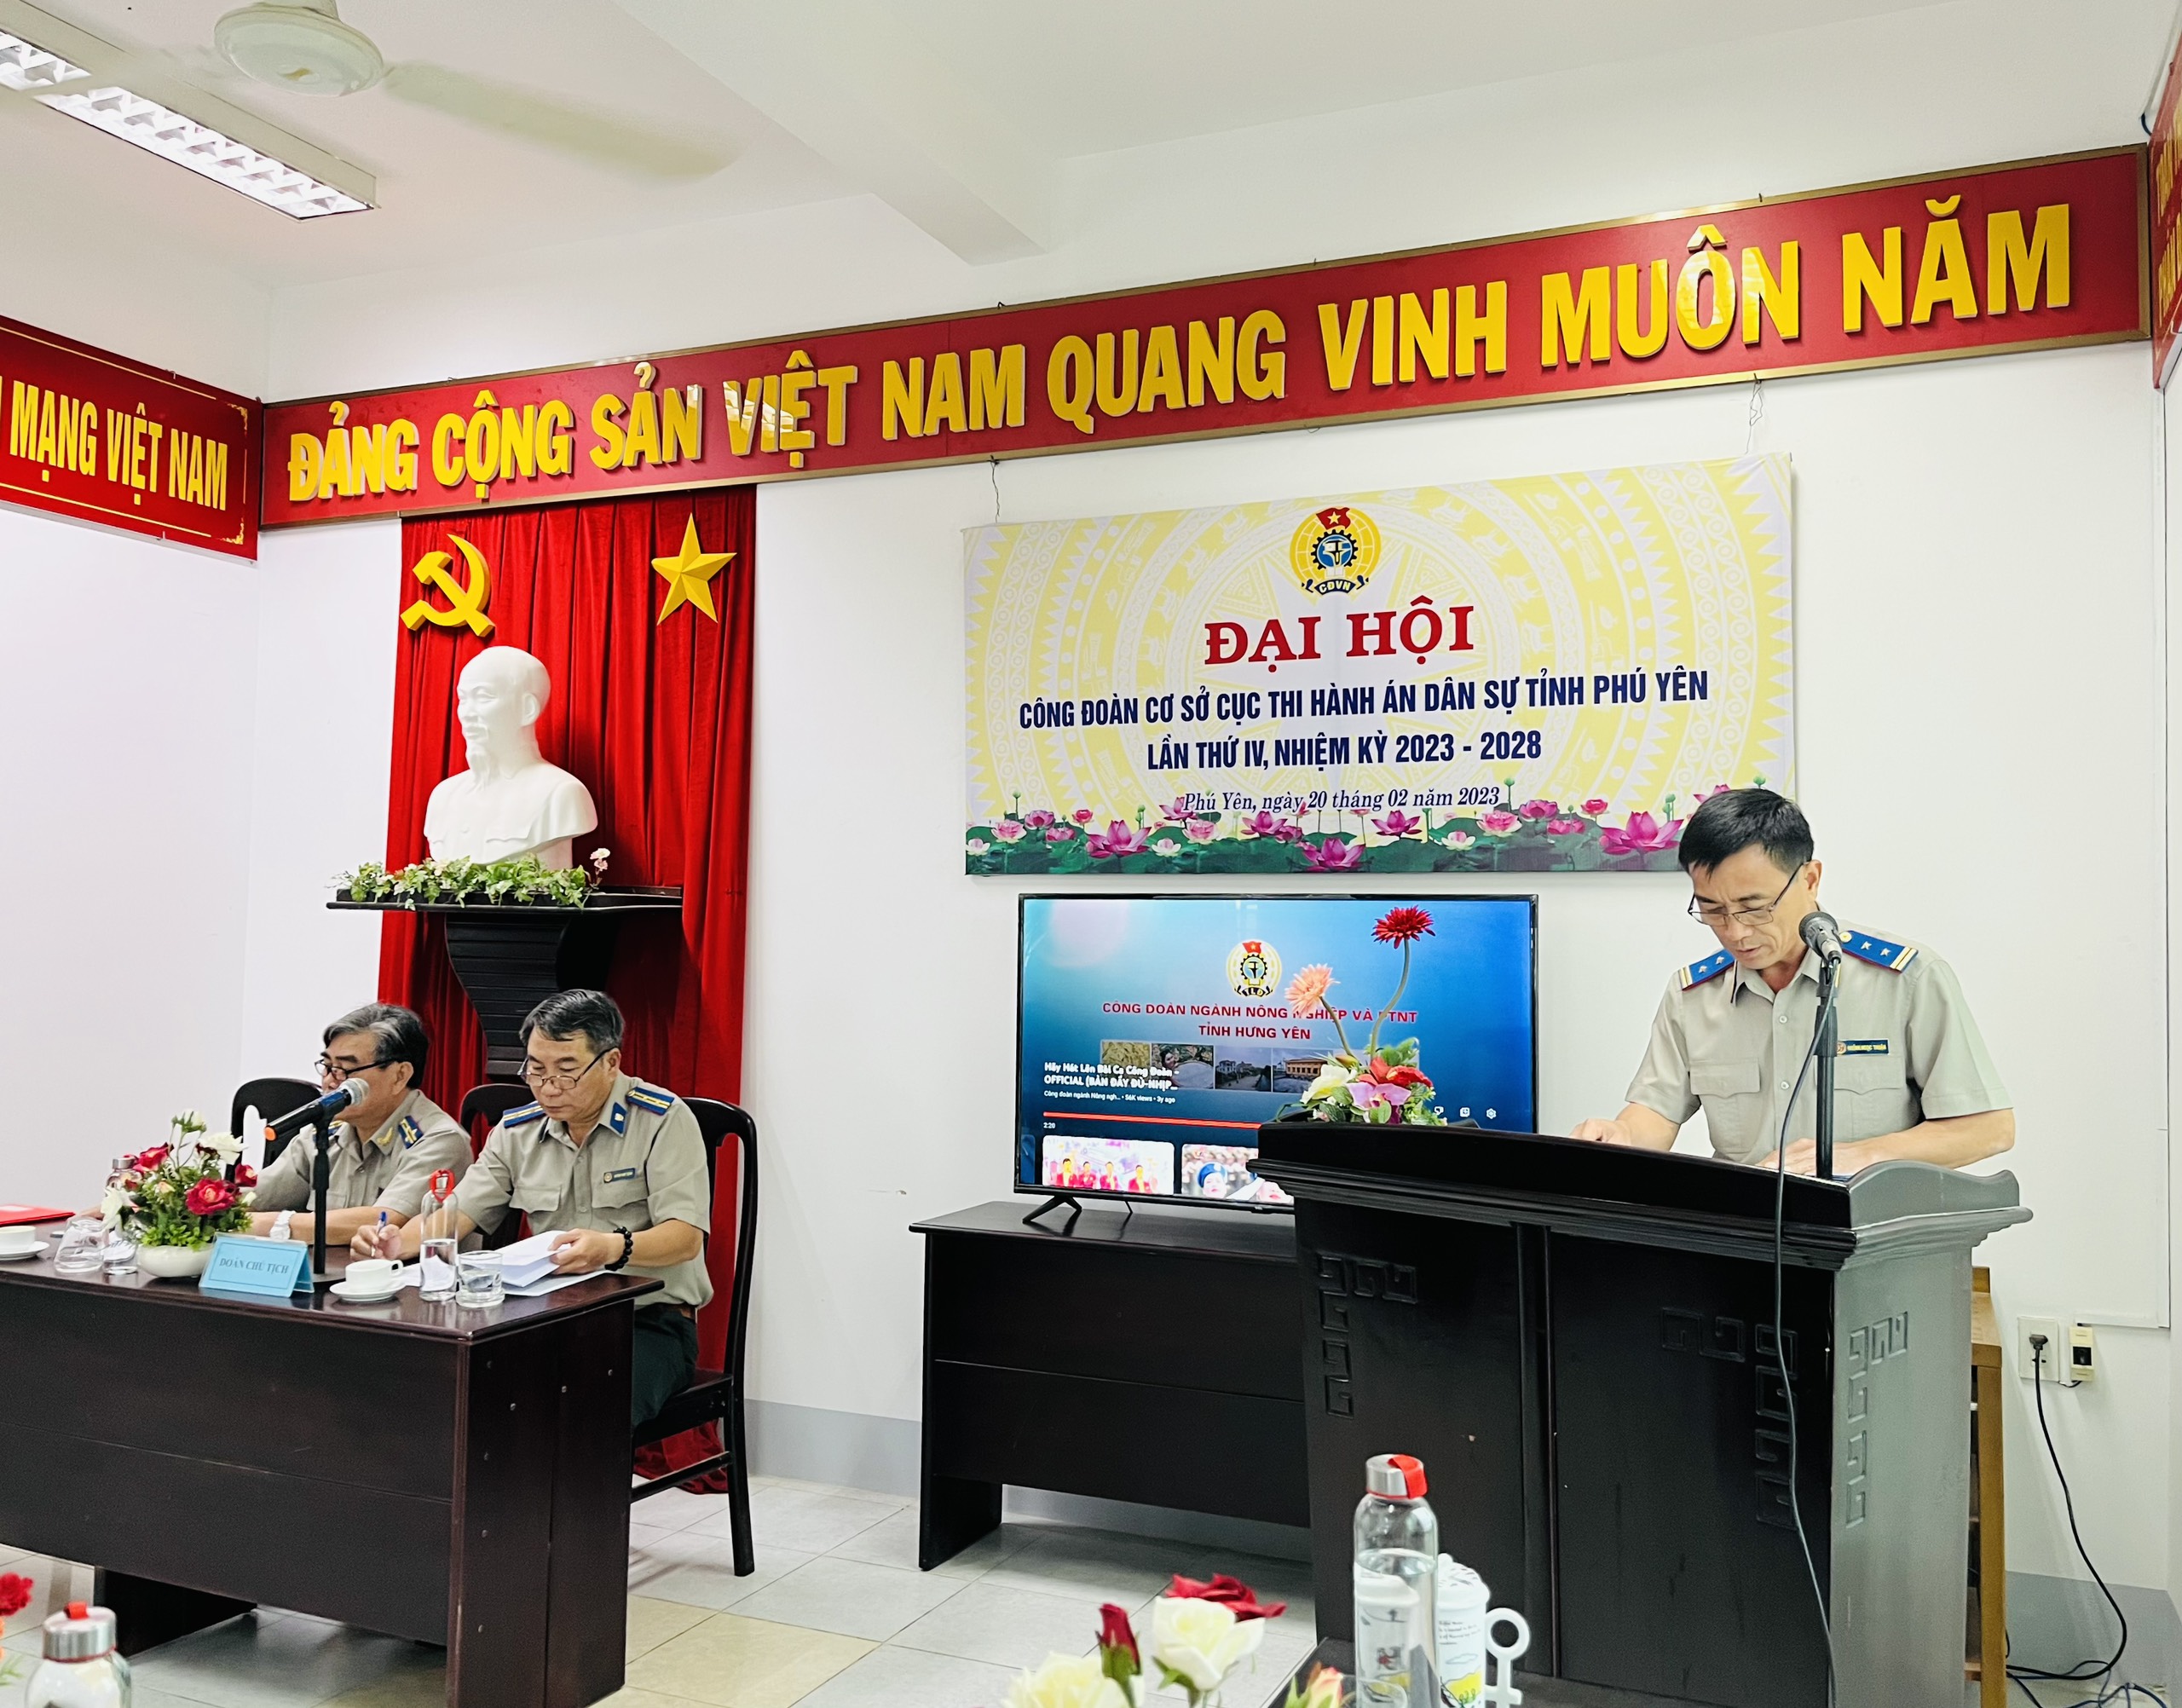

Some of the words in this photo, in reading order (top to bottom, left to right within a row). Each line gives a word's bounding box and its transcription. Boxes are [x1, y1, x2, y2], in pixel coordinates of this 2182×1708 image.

[288, 401, 419, 501] ĐẢNG
[432, 389, 574, 499] CỘNG
[589, 363, 701, 470] SẢN
[723, 350, 857, 469] VIỆT
[882, 343, 1025, 441] NAM
[1047, 309, 1286, 434] QUANG
[1318, 280, 1508, 391] VINH
[1540, 224, 1801, 370] MUÔN
[1841, 194, 2069, 333] NĂM
[9, 380, 98, 482] MẠNG
[107, 402, 163, 505] VIỆT
[168, 428, 228, 511] NAM
[1204, 616, 1321, 672] ĐẠI
[1346, 595, 1474, 666] HỘI
[1019, 696, 1075, 730] CÔNG
[1081, 691, 1139, 726] ĐOÀN
[1146, 693, 1175, 724] CƠ
[1180, 685, 1210, 722] SỞ
[1216, 691, 1261, 726] CỤC
[1267, 690, 1302, 718] THI
[1311, 682, 1375, 717] HÀNH
[1382, 679, 1416, 713] ÁN
[1424, 676, 1475, 712] DÂN
[1484, 676, 1520, 715] SỰ
[1525, 667, 1584, 707] TỈNH
[1594, 666, 1646, 705] PHÚ
[1655, 665, 1708, 702] YÊN
[1147, 733, 1189, 770] LẦN
[1195, 735, 1239, 769] THỨ
[1244, 740, 1268, 770] IV,
[1274, 731, 1350, 772] NHIỆM
[1358, 730, 1388, 764] KỲ
[1395, 733, 1454, 763] 2023
[1480, 730, 1541, 760] 2028
[1183, 793, 1216, 811] Phú
[1222, 792, 1256, 812] Yên,
[1262, 791, 1304, 813] ngày
[1307, 790, 1327, 808] 20
[1332, 789, 1384, 811] tháng
[1388, 788, 1408, 806] 02
[1412, 788, 1452, 806] năm
[1458, 787, 1500, 805] 2023
[1102, 1000, 1141, 1014] CÔNG
[1190, 1003, 1241, 1016] NGÀNH
[1245, 1004, 1288, 1018] NÔNG
[1352, 1007, 1373, 1021] VÀ
[1379, 1011, 1417, 1023] TNT
[1198, 1022, 1231, 1036] TỈNH
[1236, 1025, 1277, 1038] HƯNG
[1282, 1026, 1311, 1040] YÊN
[1044, 1075, 1084, 1086] OFFICIAL
